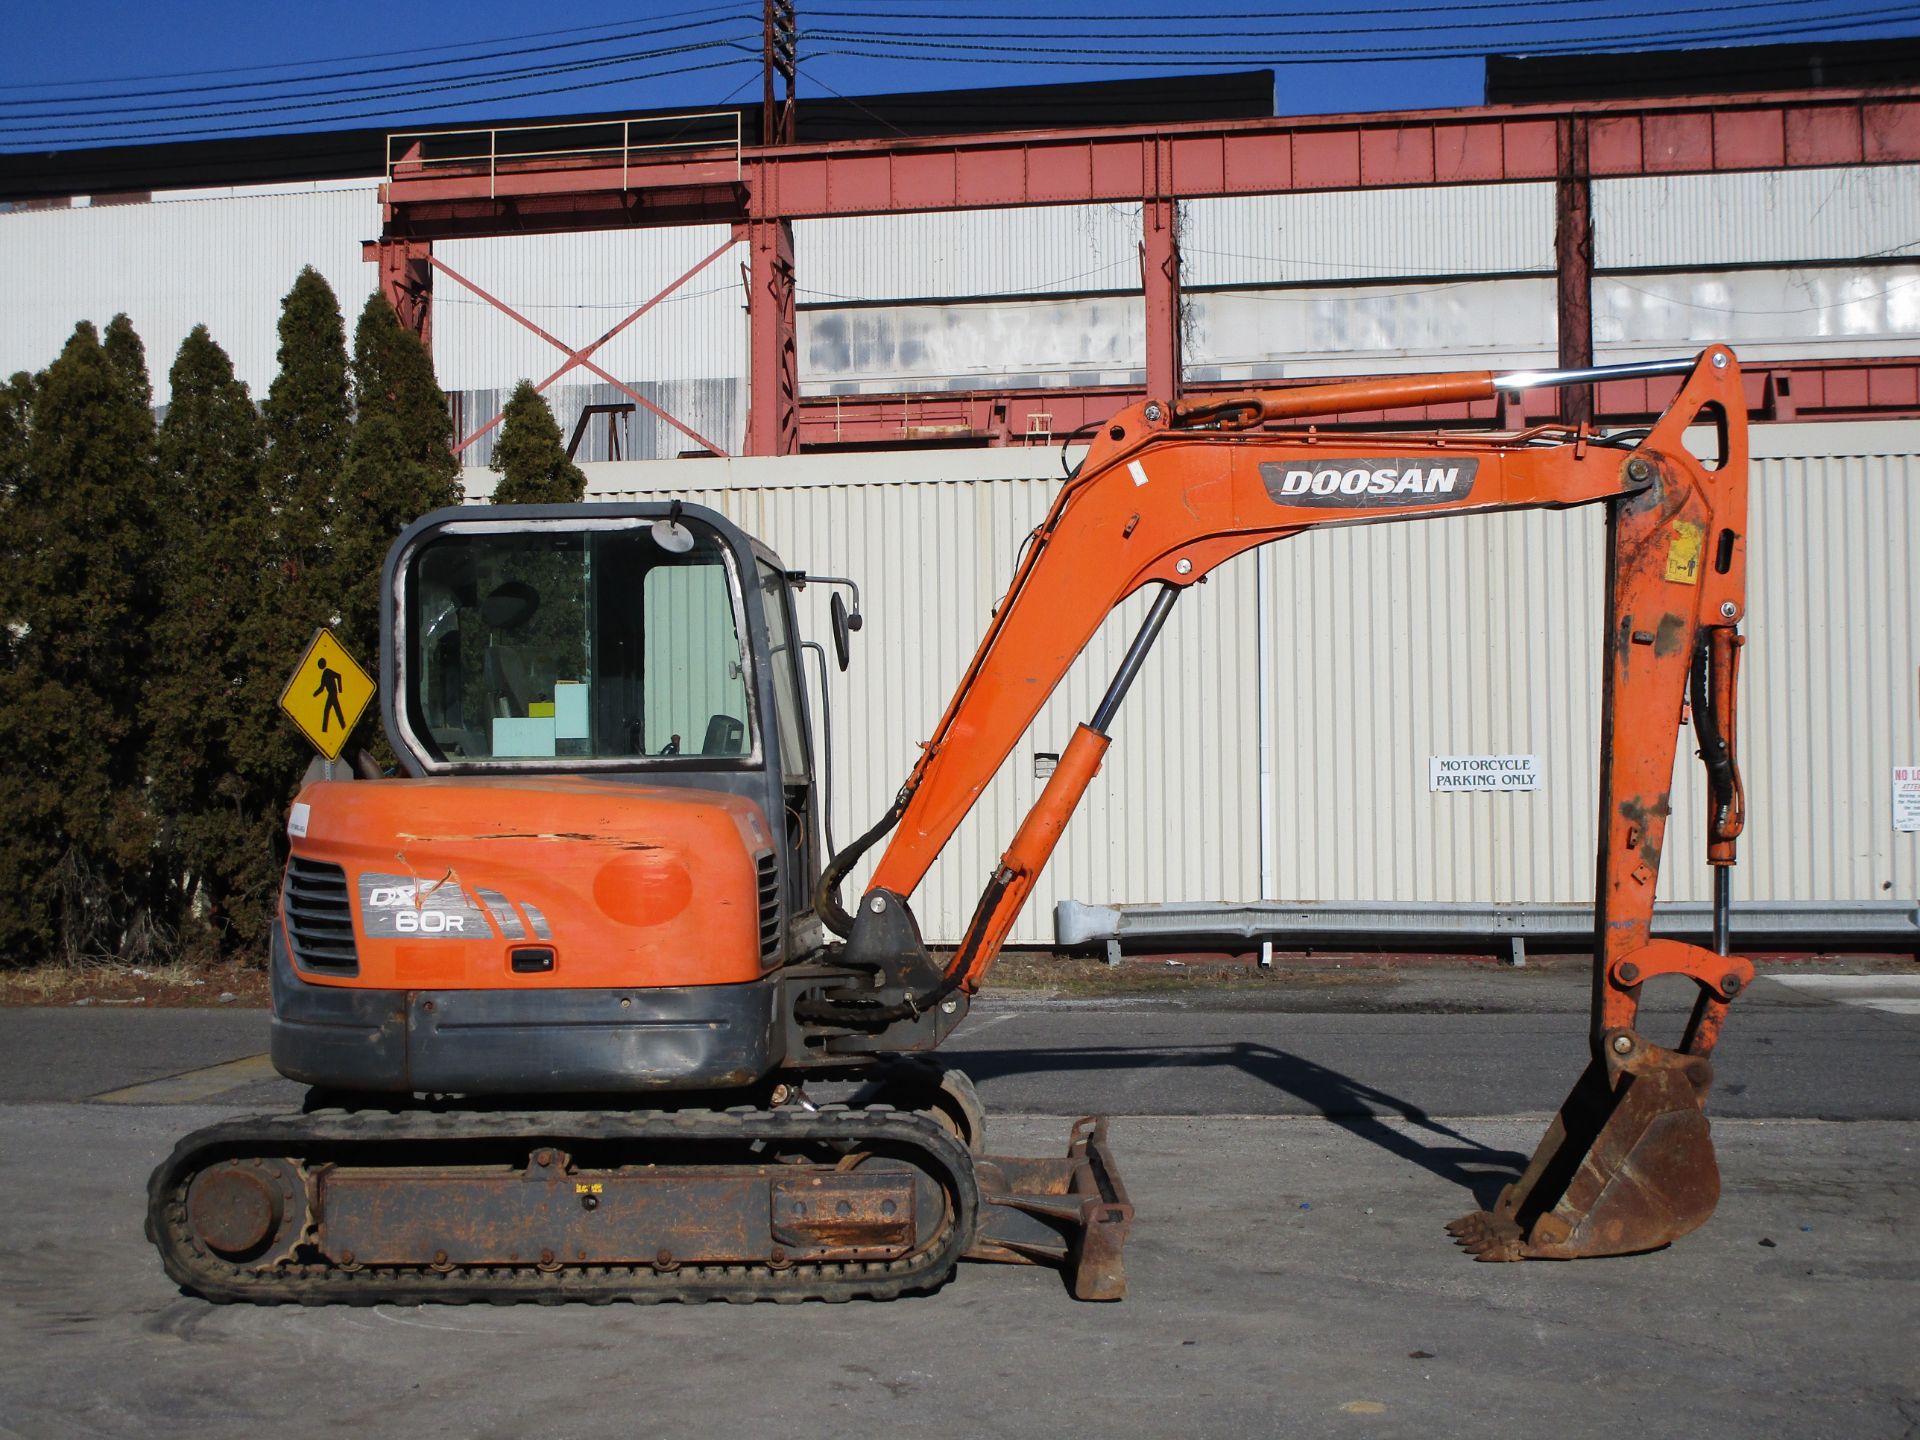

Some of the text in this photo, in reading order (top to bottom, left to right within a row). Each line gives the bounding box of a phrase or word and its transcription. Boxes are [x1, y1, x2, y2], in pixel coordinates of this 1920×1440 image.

[1280, 468, 1459, 495] DOOSAN
[1440, 760, 1530, 771] MOTORCYCLE
[1436, 774, 1536, 785] PARKING ONLY
[1895, 769, 1908, 780] NO
[396, 911, 464, 932] 60R
